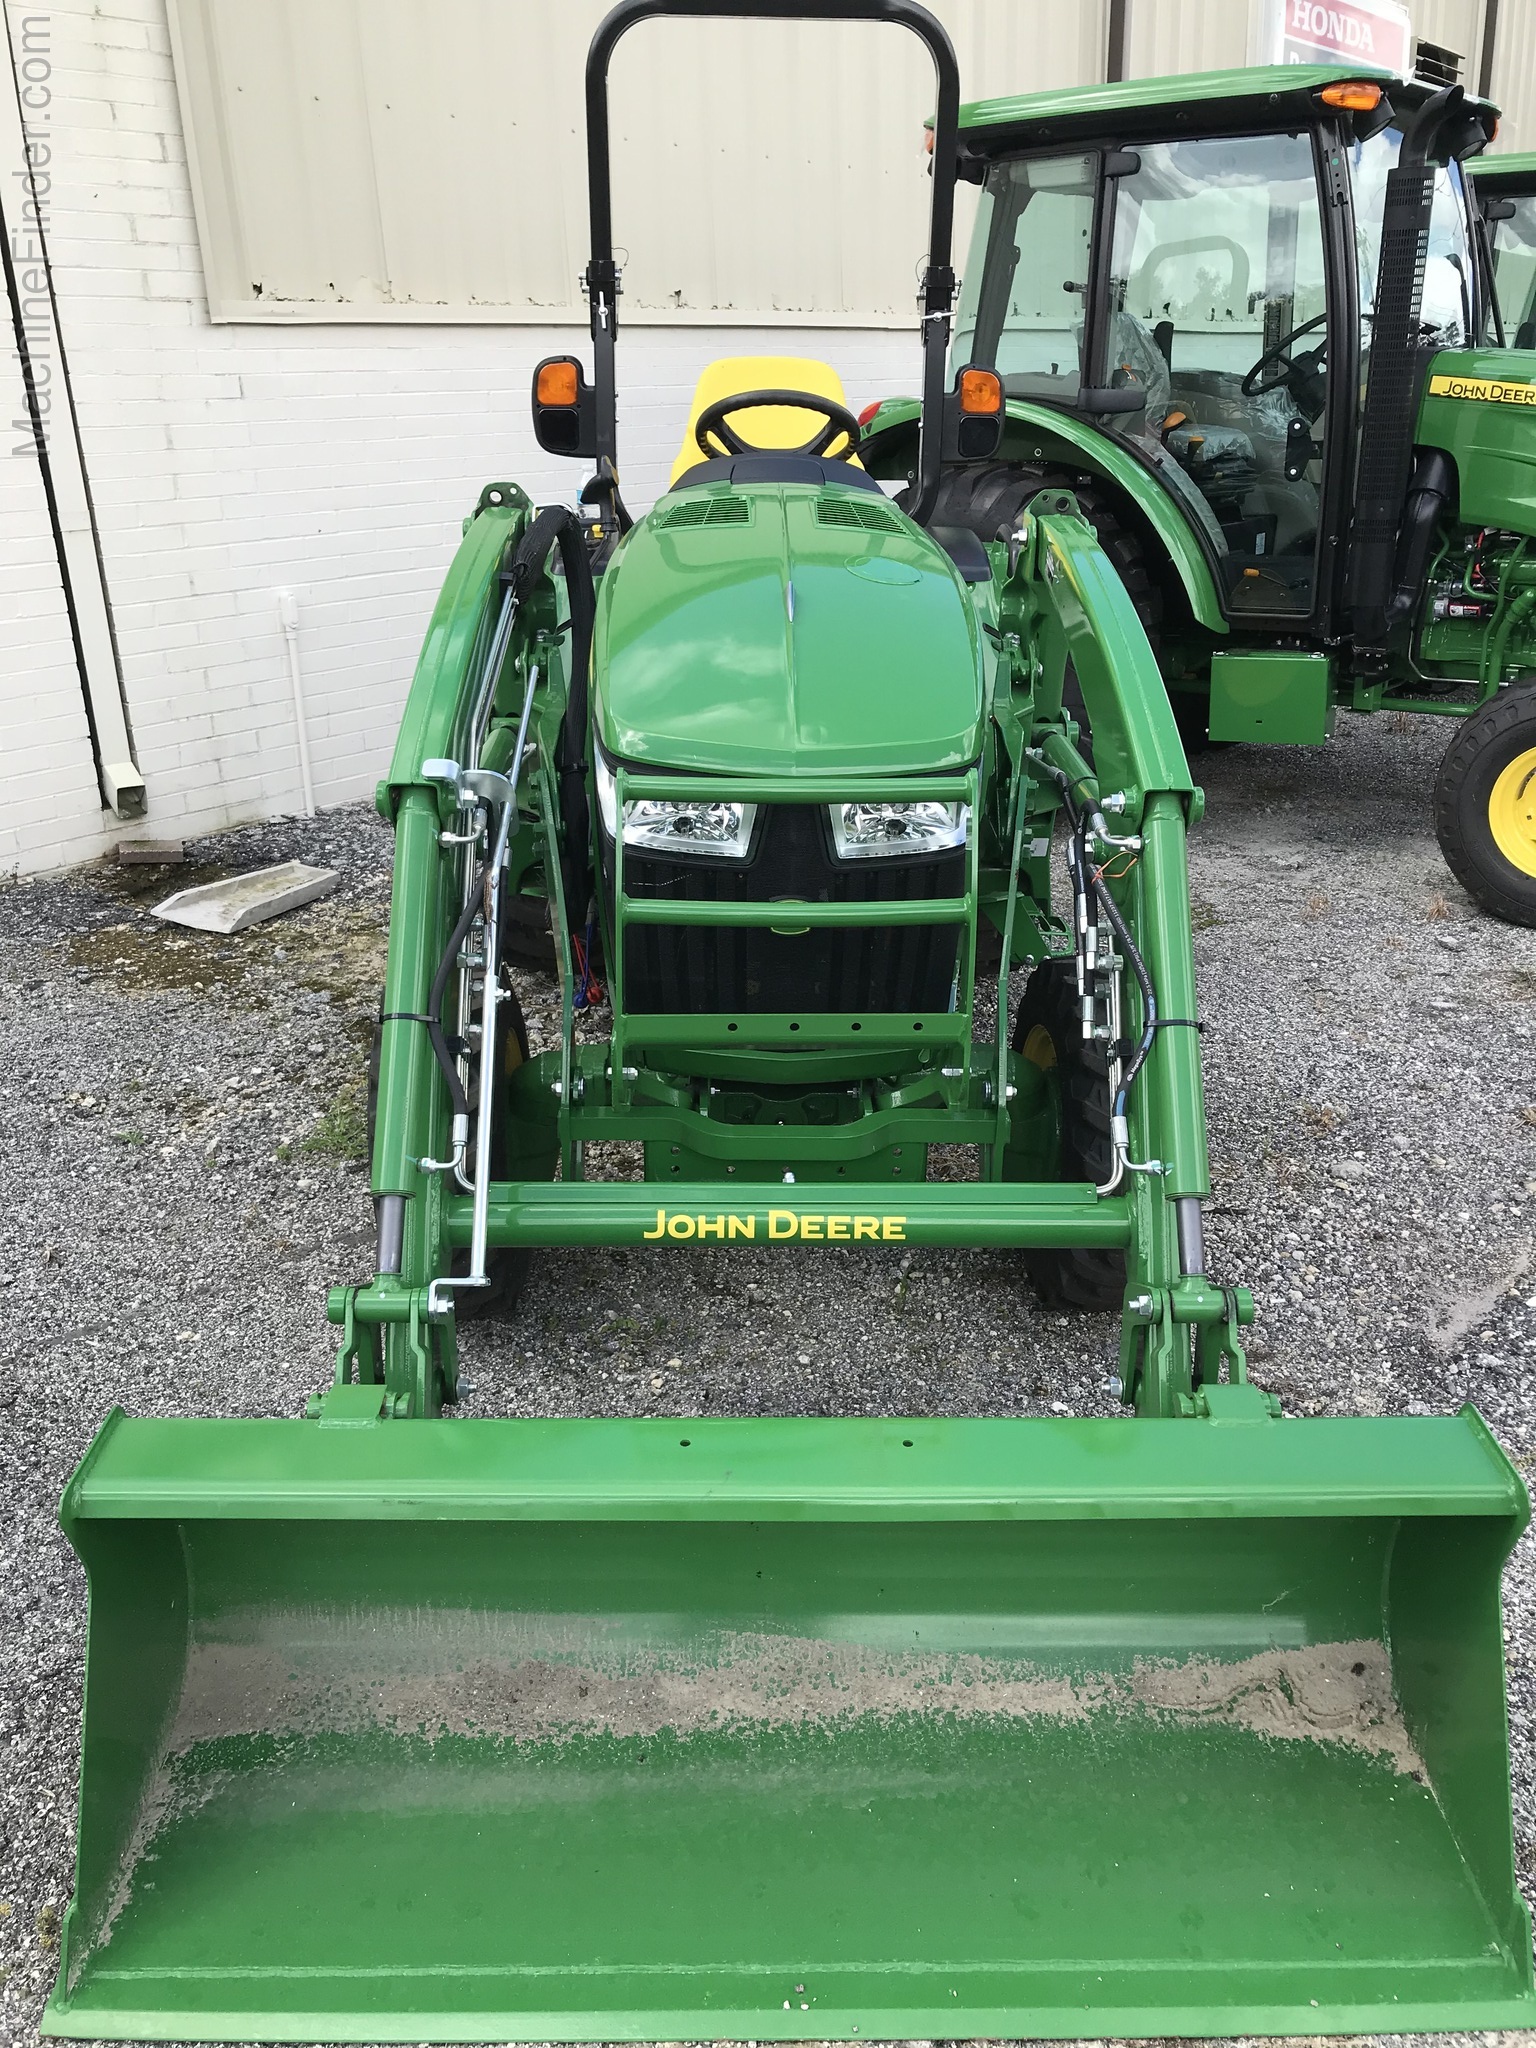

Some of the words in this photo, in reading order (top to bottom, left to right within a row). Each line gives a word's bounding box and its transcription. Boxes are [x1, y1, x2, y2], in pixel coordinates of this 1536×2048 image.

[1292, 0, 1375, 53] HONDA
[1443, 381, 1486, 398] JOHN
[1490, 385, 1536, 402] DEER
[643, 1210, 755, 1239] JOHN
[768, 1210, 907, 1240] DEERE
